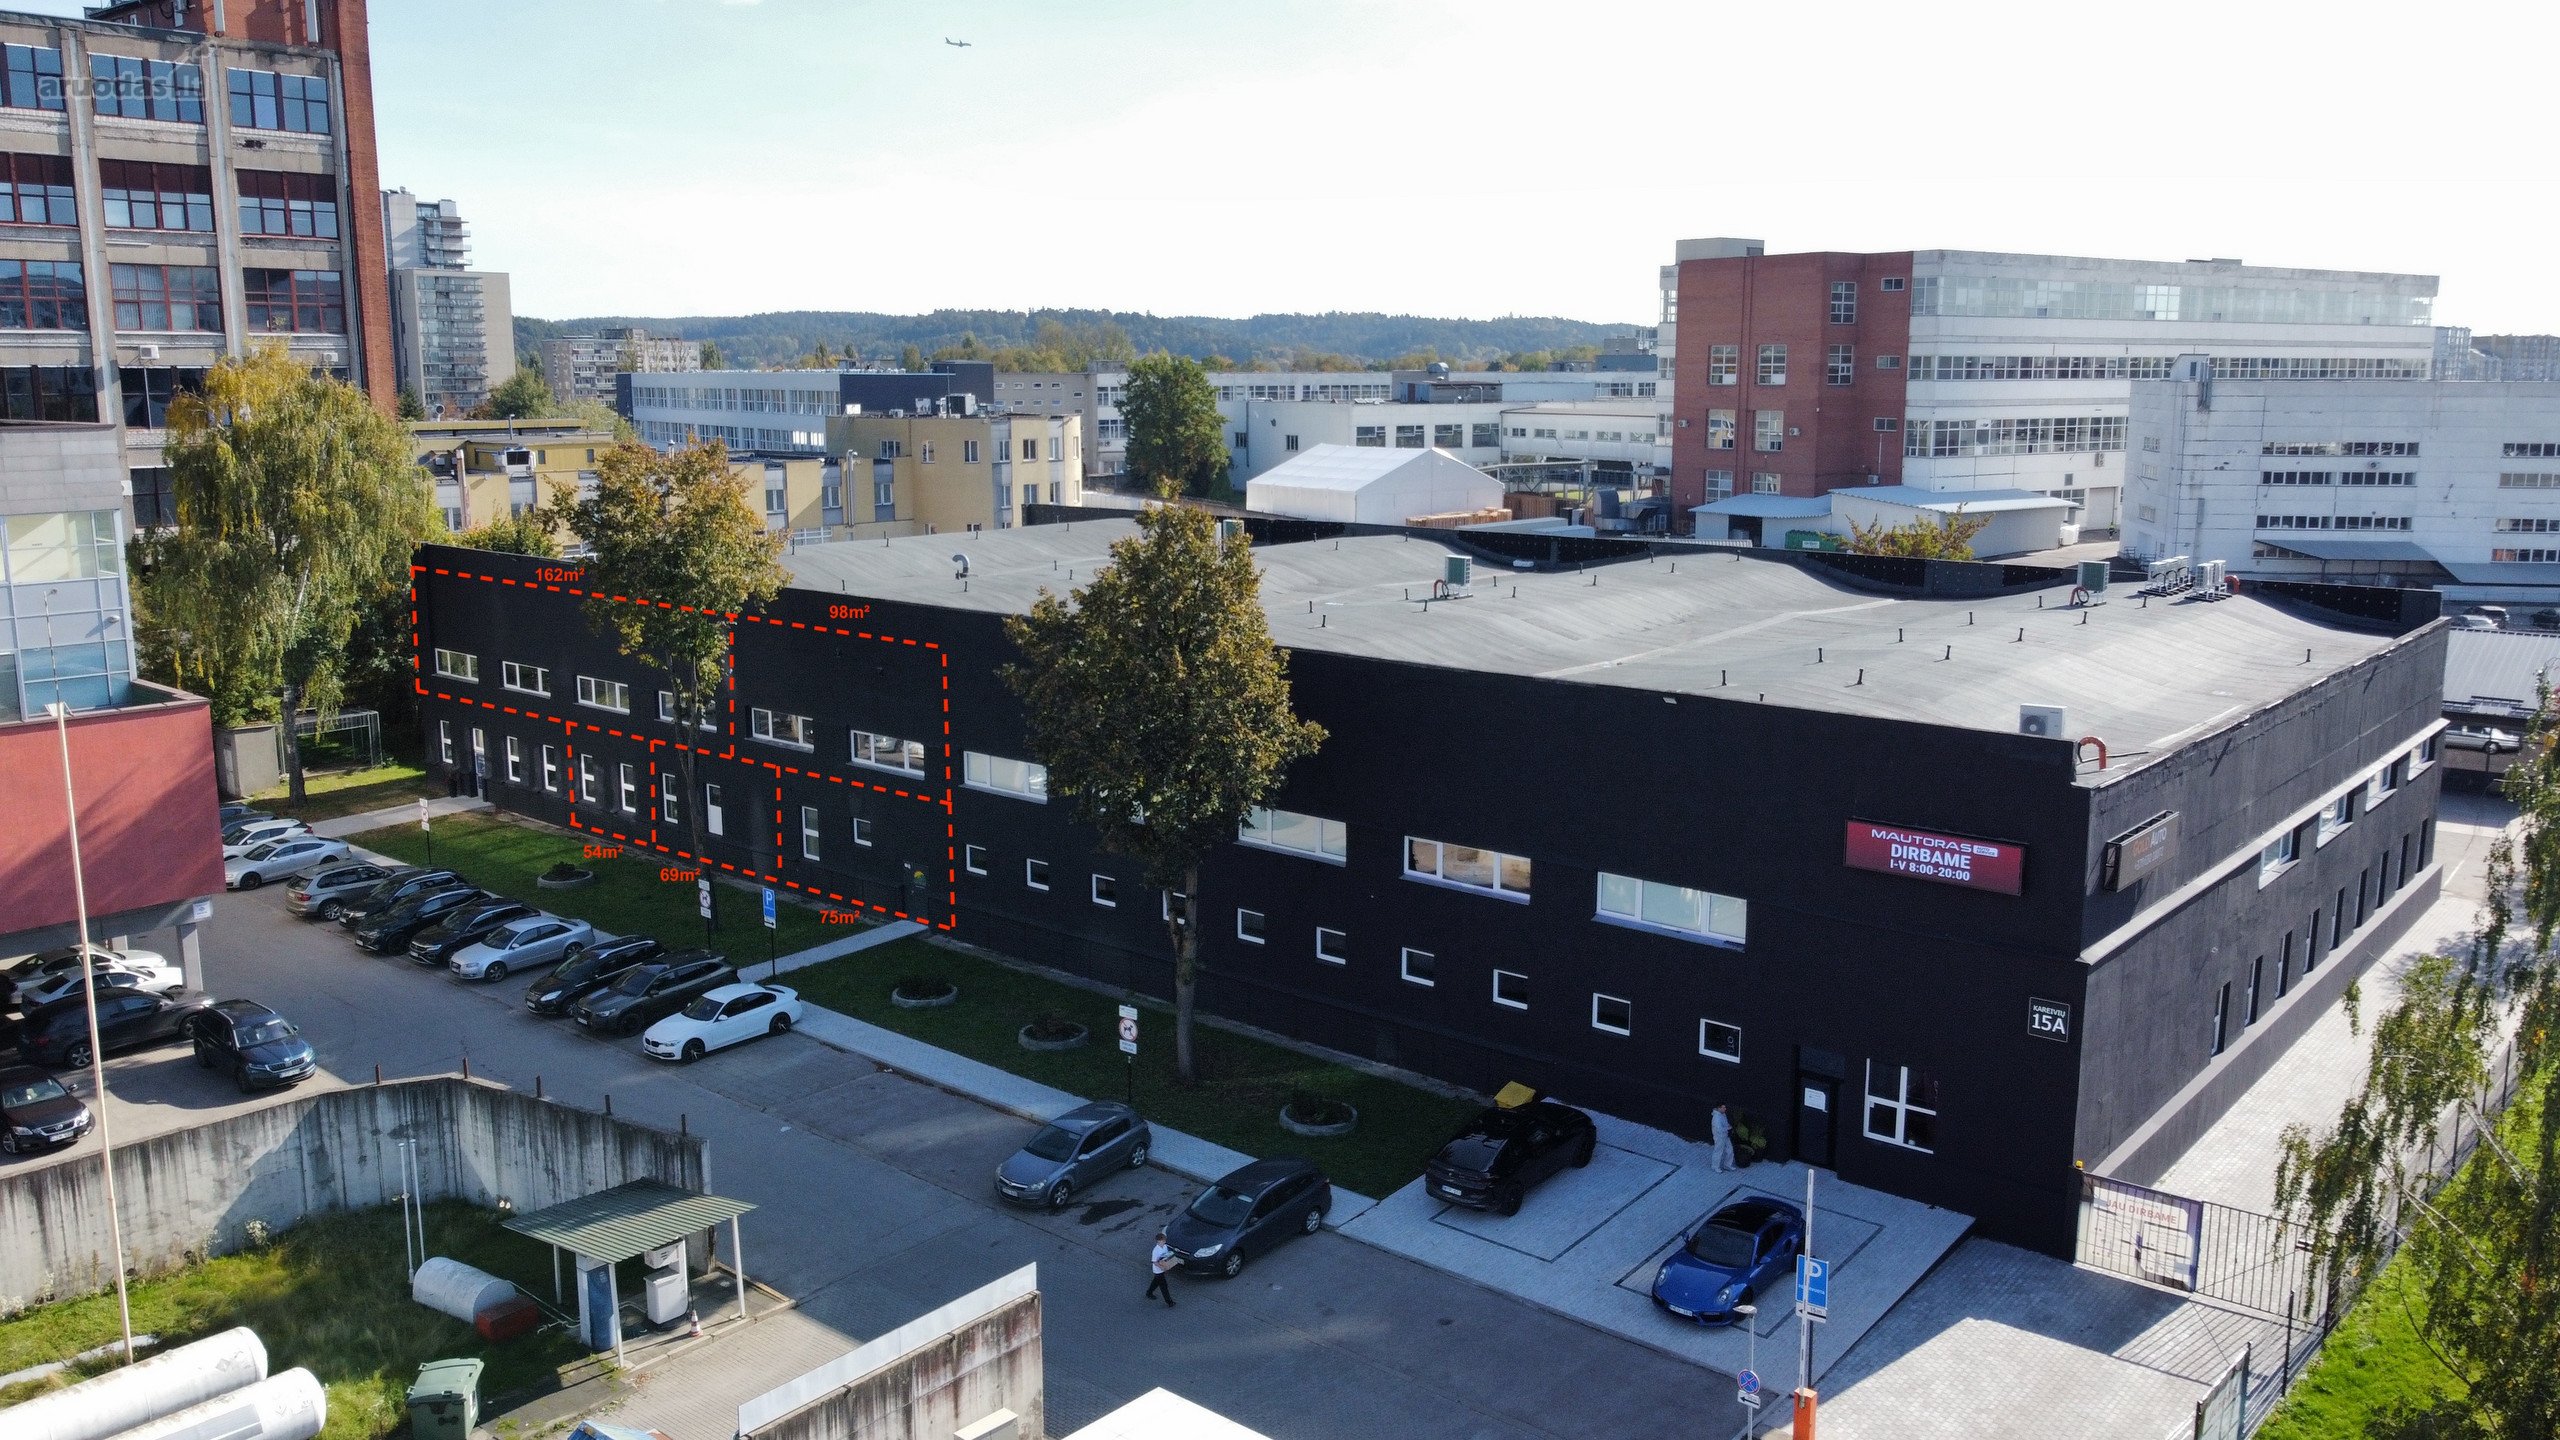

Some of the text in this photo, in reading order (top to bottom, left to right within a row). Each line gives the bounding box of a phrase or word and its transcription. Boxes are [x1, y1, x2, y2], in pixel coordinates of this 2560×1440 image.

[1871, 828, 1973, 853] MAUTORAS
[1890, 844, 1972, 870] DIRBAME
[1889, 860, 1971, 882] I-V 8:00-20:00
[765, 890, 773, 906] P
[2031, 1013, 2066, 1035] 15A
[2105, 1199, 2178, 1225] JAU DIRBAME
